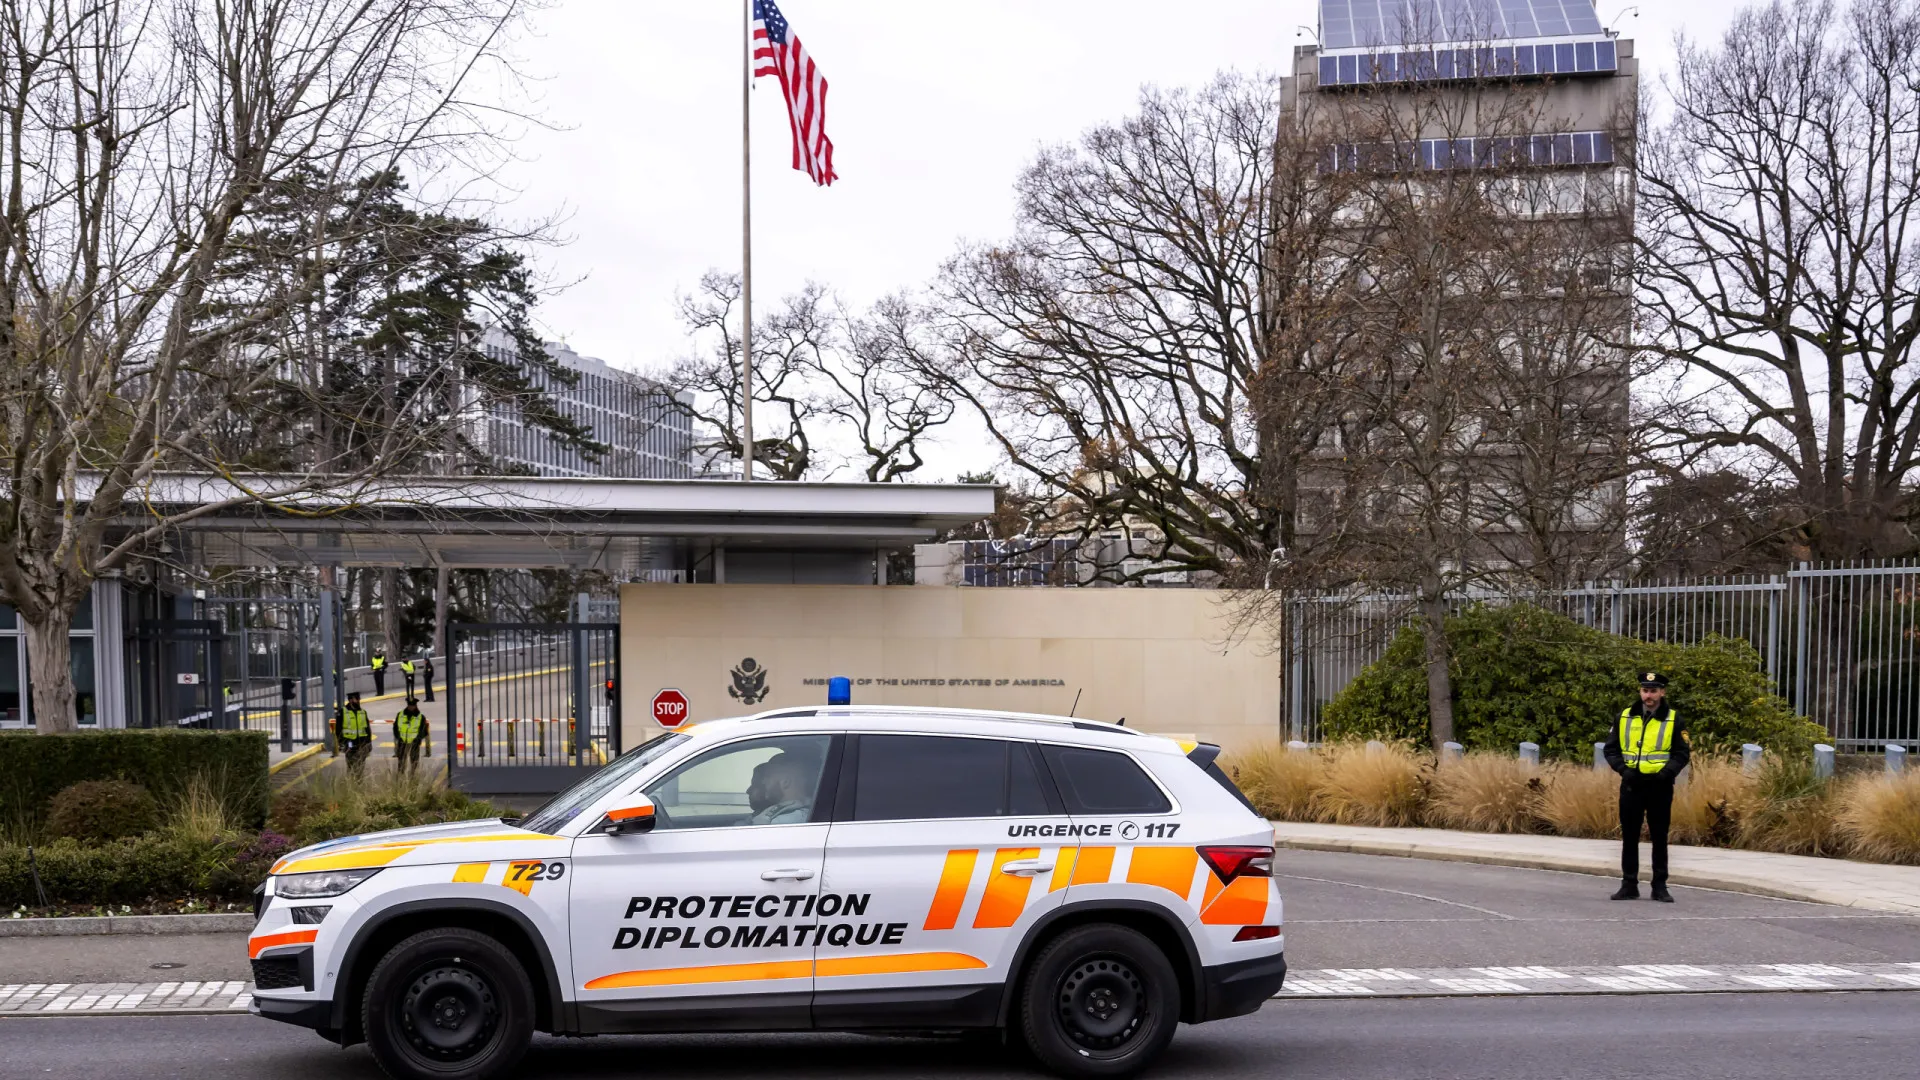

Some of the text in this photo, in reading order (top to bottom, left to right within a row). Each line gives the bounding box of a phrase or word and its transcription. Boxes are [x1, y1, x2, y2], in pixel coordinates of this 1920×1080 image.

[856, 678, 873, 686] OF
[875, 678, 899, 686] THE
[901, 678, 946, 686] UNITED
[948, 678, 992, 687] STATES
[994, 679, 1010, 687] OF
[1012, 679, 1066, 687] AMERICA
[656, 702, 685, 715] STOP
[1007, 823, 1181, 838] URGENCE 117
[511, 861, 566, 882] 729
[623, 893, 872, 920] PROTECTION
[611, 922, 909, 950] DIPLOMATIQUE
